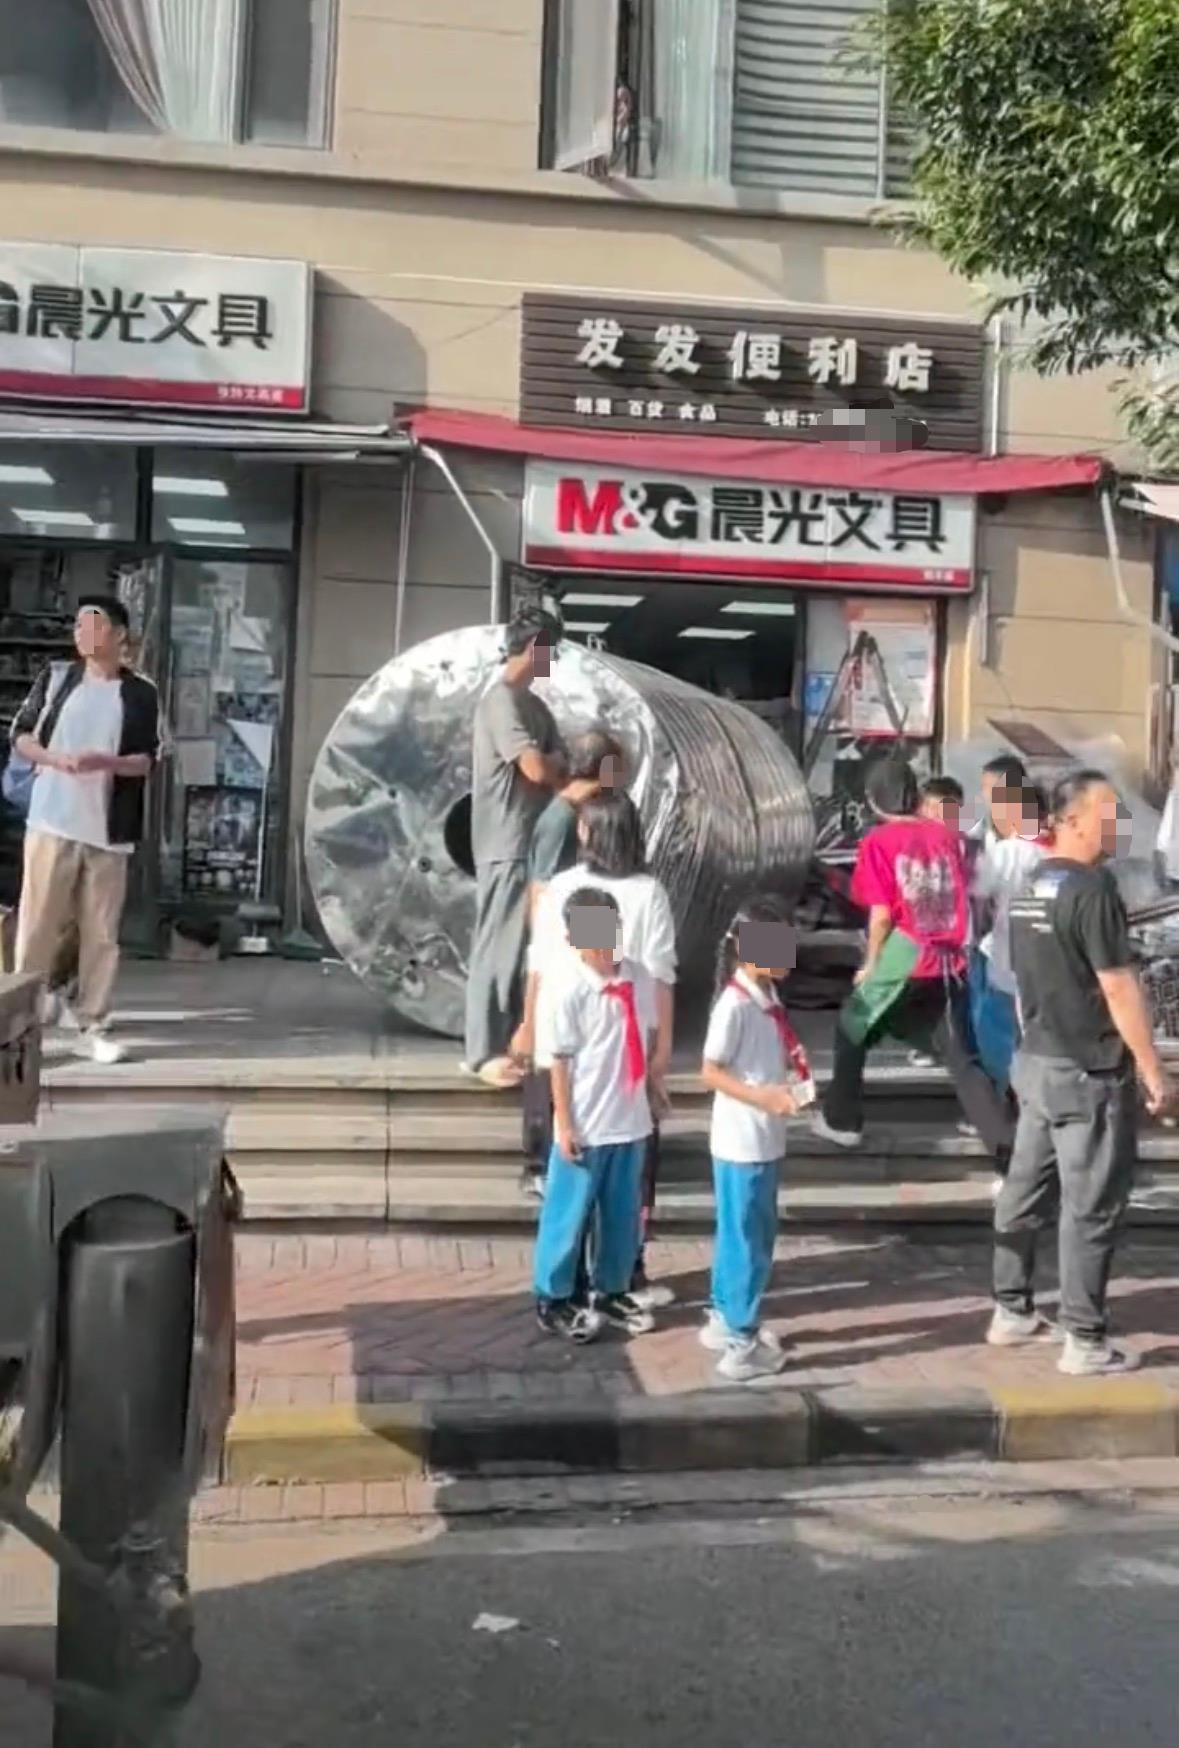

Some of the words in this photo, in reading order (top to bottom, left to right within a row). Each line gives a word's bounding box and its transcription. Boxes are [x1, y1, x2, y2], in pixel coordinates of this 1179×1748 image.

[26, 284, 273, 350] 晨光文具
[576, 318, 933, 392] 发发便利店
[557, 478, 699, 539] M&G
[709, 486, 947, 554] 晨光文具
